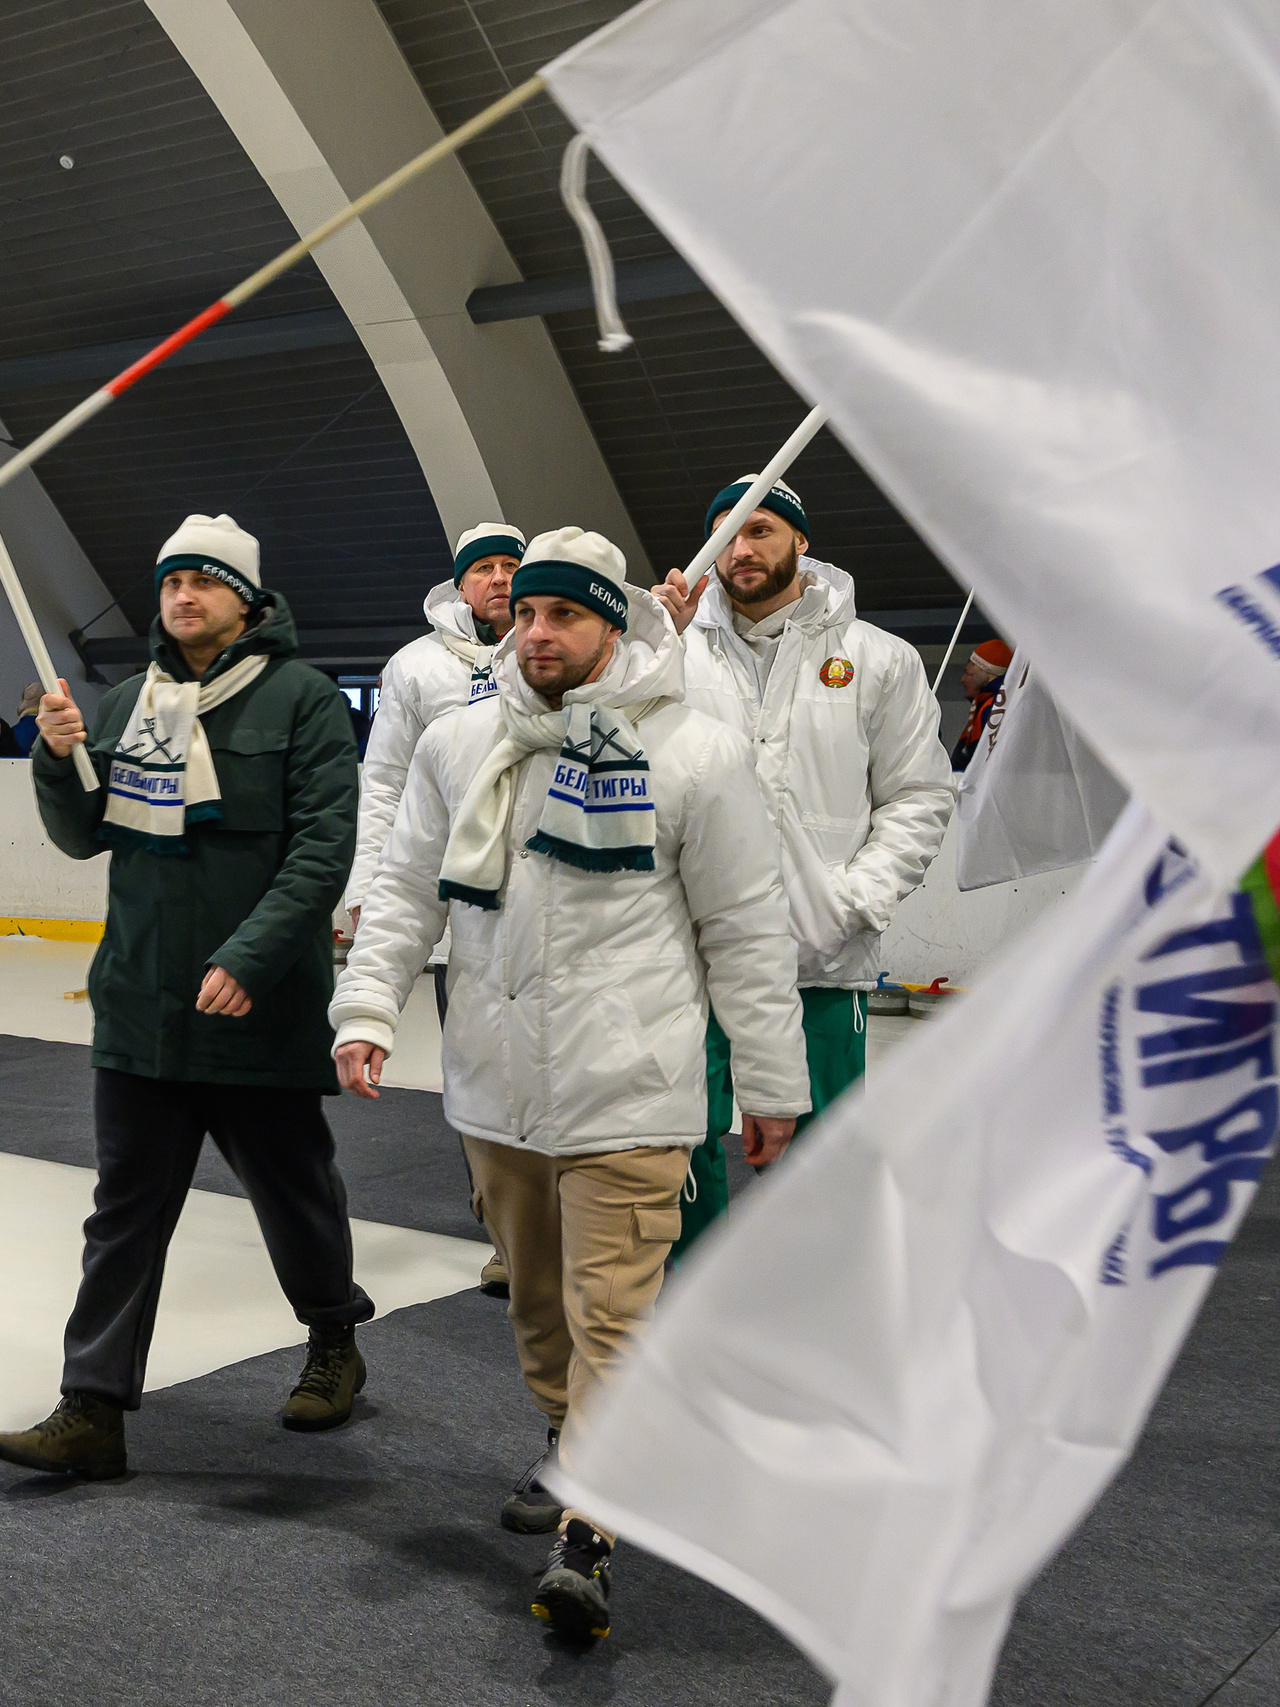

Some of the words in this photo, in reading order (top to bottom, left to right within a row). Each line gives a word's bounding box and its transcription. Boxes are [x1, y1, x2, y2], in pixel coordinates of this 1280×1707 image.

[589, 582, 628, 619] БЕЛАРУ
[470, 676, 498, 698] БЕЛЫ
[592, 777, 647, 799] ТИГРЫ
[1135, 891, 1278, 1280] ТИГРЫ
